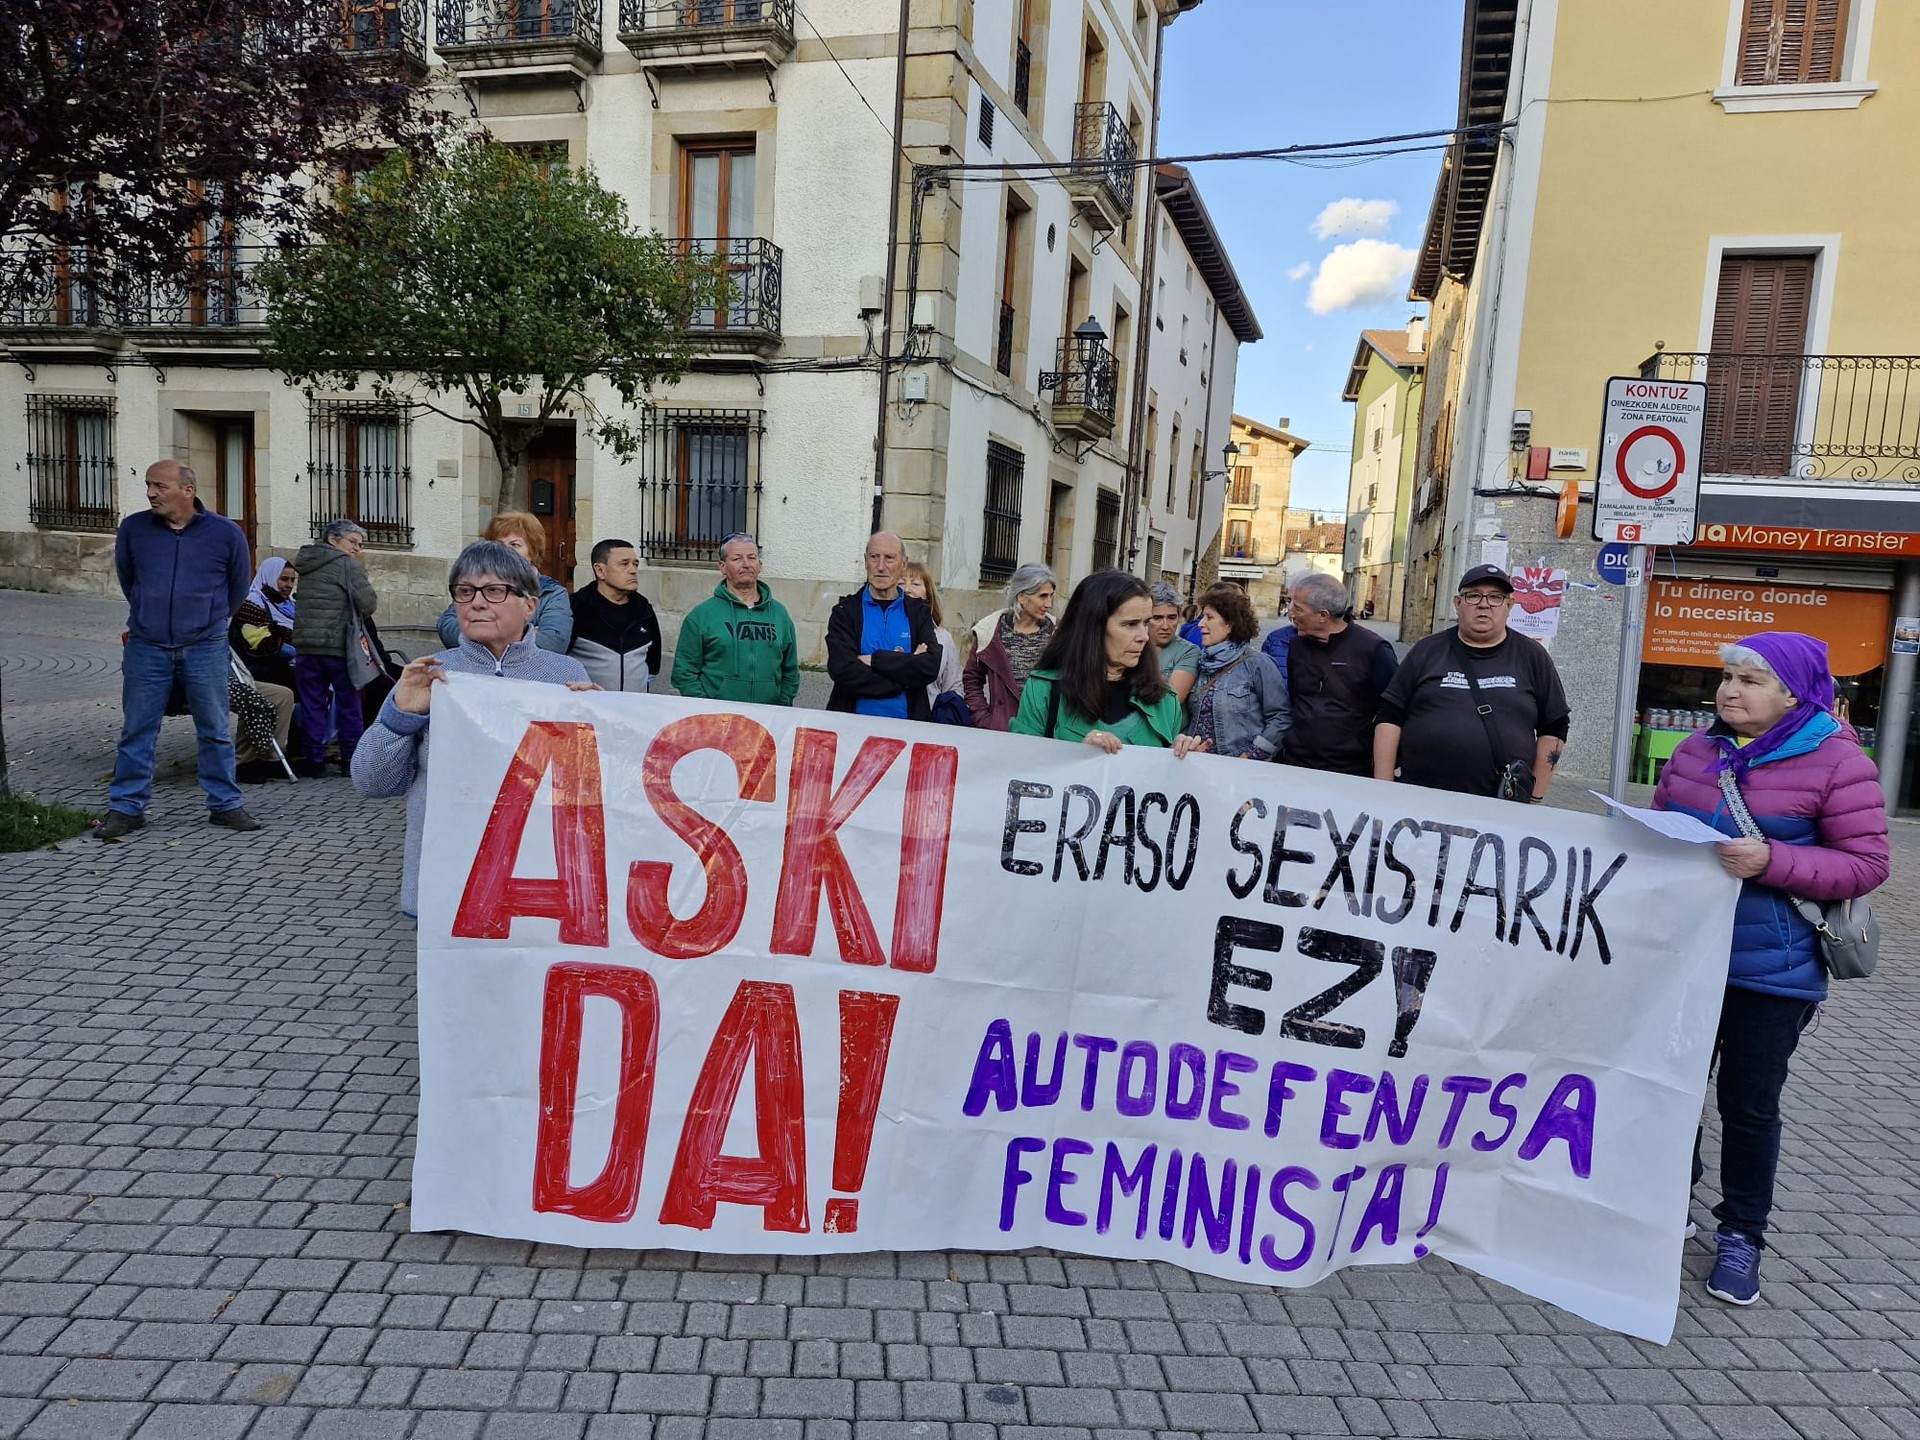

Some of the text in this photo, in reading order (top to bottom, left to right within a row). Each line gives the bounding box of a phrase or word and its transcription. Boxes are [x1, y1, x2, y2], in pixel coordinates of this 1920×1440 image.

[1625, 384, 1689, 400] KONTUZ
[519, 405, 529, 414] 15
[1611, 400, 1701, 412] OINEZKOEN ALDERDIA
[1646, 414, 1688, 423] PEATONAL
[1648, 505, 1695, 513] BAIMENDUTAKO
[1698, 524, 1909, 550] ia Money Transfer
[1658, 581, 1828, 606] Tu dinero donde
[1654, 601, 1775, 624] lo necesitas
[724, 621, 777, 642] VANS
[1665, 645, 1688, 653] oficina
[451, 713, 959, 973] ASKI
[1000, 778, 1628, 965] ERASO SEXISTARIK
[1206, 915, 1438, 1058] EZ!
[532, 961, 900, 1234] DA!
[962, 1018, 1598, 1179] AUTODEFENTSA
[999, 1136, 1451, 1272] FEMINISTA!
